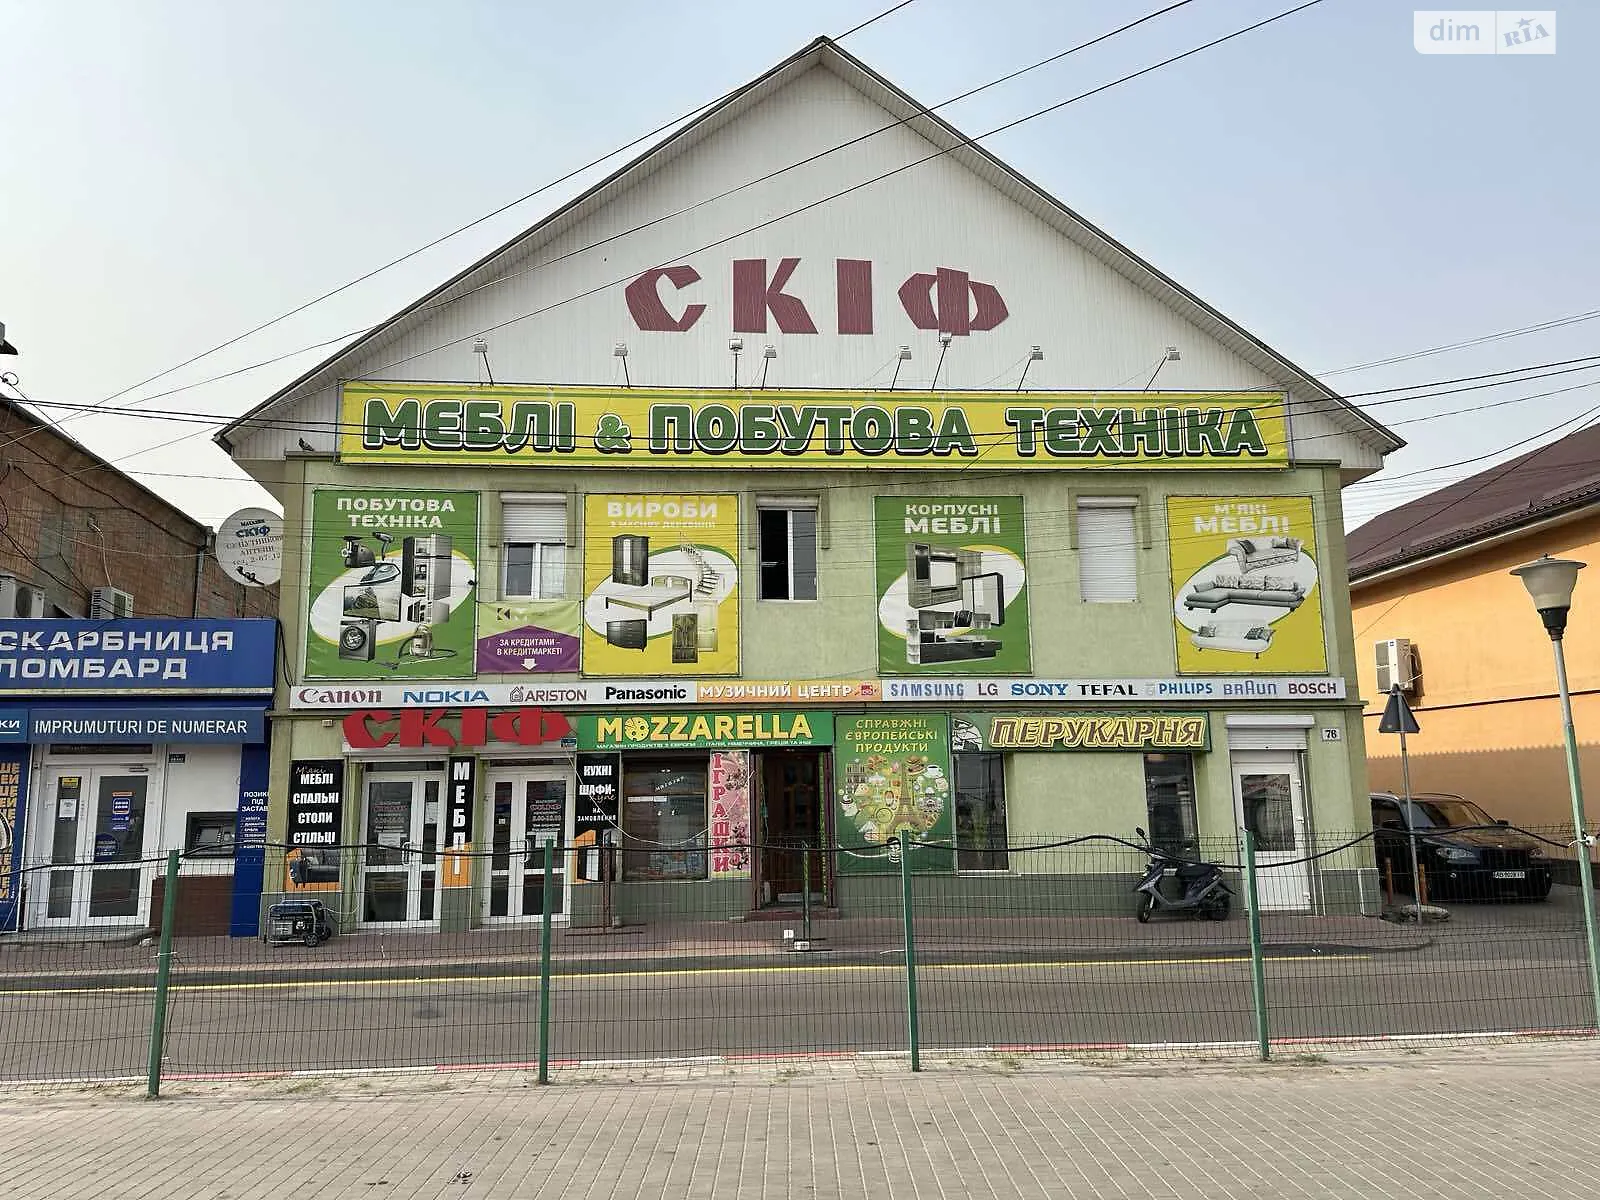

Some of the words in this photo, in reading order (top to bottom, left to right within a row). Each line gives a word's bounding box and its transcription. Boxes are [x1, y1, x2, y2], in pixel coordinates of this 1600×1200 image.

[625, 257, 1009, 336] СКІФ
[363, 399, 576, 453] МЕБЛІ
[595, 414, 632, 453] &
[649, 404, 978, 456] ПОБУТОВА
[1006, 407, 1268, 456] ТЕХНІКА
[337, 497, 456, 512] ПОБУТОВА
[607, 502, 717, 518] ВИРОБИ
[905, 504, 998, 515] КОРПУСНІ
[348, 514, 443, 529] ТЕХНІКА
[904, 517, 1000, 534] МЕБЛІ
[1194, 515, 1289, 533] МЕБЛІ
[499, 639, 509, 647] ЗА
[510, 638, 555, 647] КРЕДИТАМИ
[496, 647, 502, 656] В
[298, 688, 382, 704] Canon
[403, 690, 490, 703] NOKIA
[525, 688, 587, 702] ARISTON
[605, 685, 687, 700] Panasonic
[700, 681, 792, 698] МУЗИЧНИЙ
[797, 682, 851, 699] ЦЕНТР
[891, 683, 964, 697] SAMSUNG
[978, 683, 998, 696] LG
[1011, 683, 1068, 696] SONY
[1077, 683, 1138, 696] TEFAL
[1158, 682, 1213, 695] PHILIPS
[1288, 682, 1337, 695] BOSCH
[35, 720, 143, 735] IMPRUMUTURI
[147, 720, 167, 734] DE
[171, 720, 248, 734] NUMERAR
[342, 707, 571, 749] СКІФ
[597, 713, 813, 743] MOZZARELLA
[856, 719, 927, 728] СПРАВЖНІ
[845, 728, 938, 740] ЄВРОПЕЙСЬКІ
[989, 716, 1206, 747] ПЕРУКАРНЯ
[855, 742, 928, 753] ПРОДУКТИ
[583, 765, 613, 777] КУХНІ
[300, 773, 334, 785] МЕБЛІ
[251, 798, 264, 806] ПІД
[292, 792, 339, 805] СПАЛЬНІ
[298, 811, 333, 824] СТОЛИ
[293, 832, 336, 845] СТІЛЬЦІ
